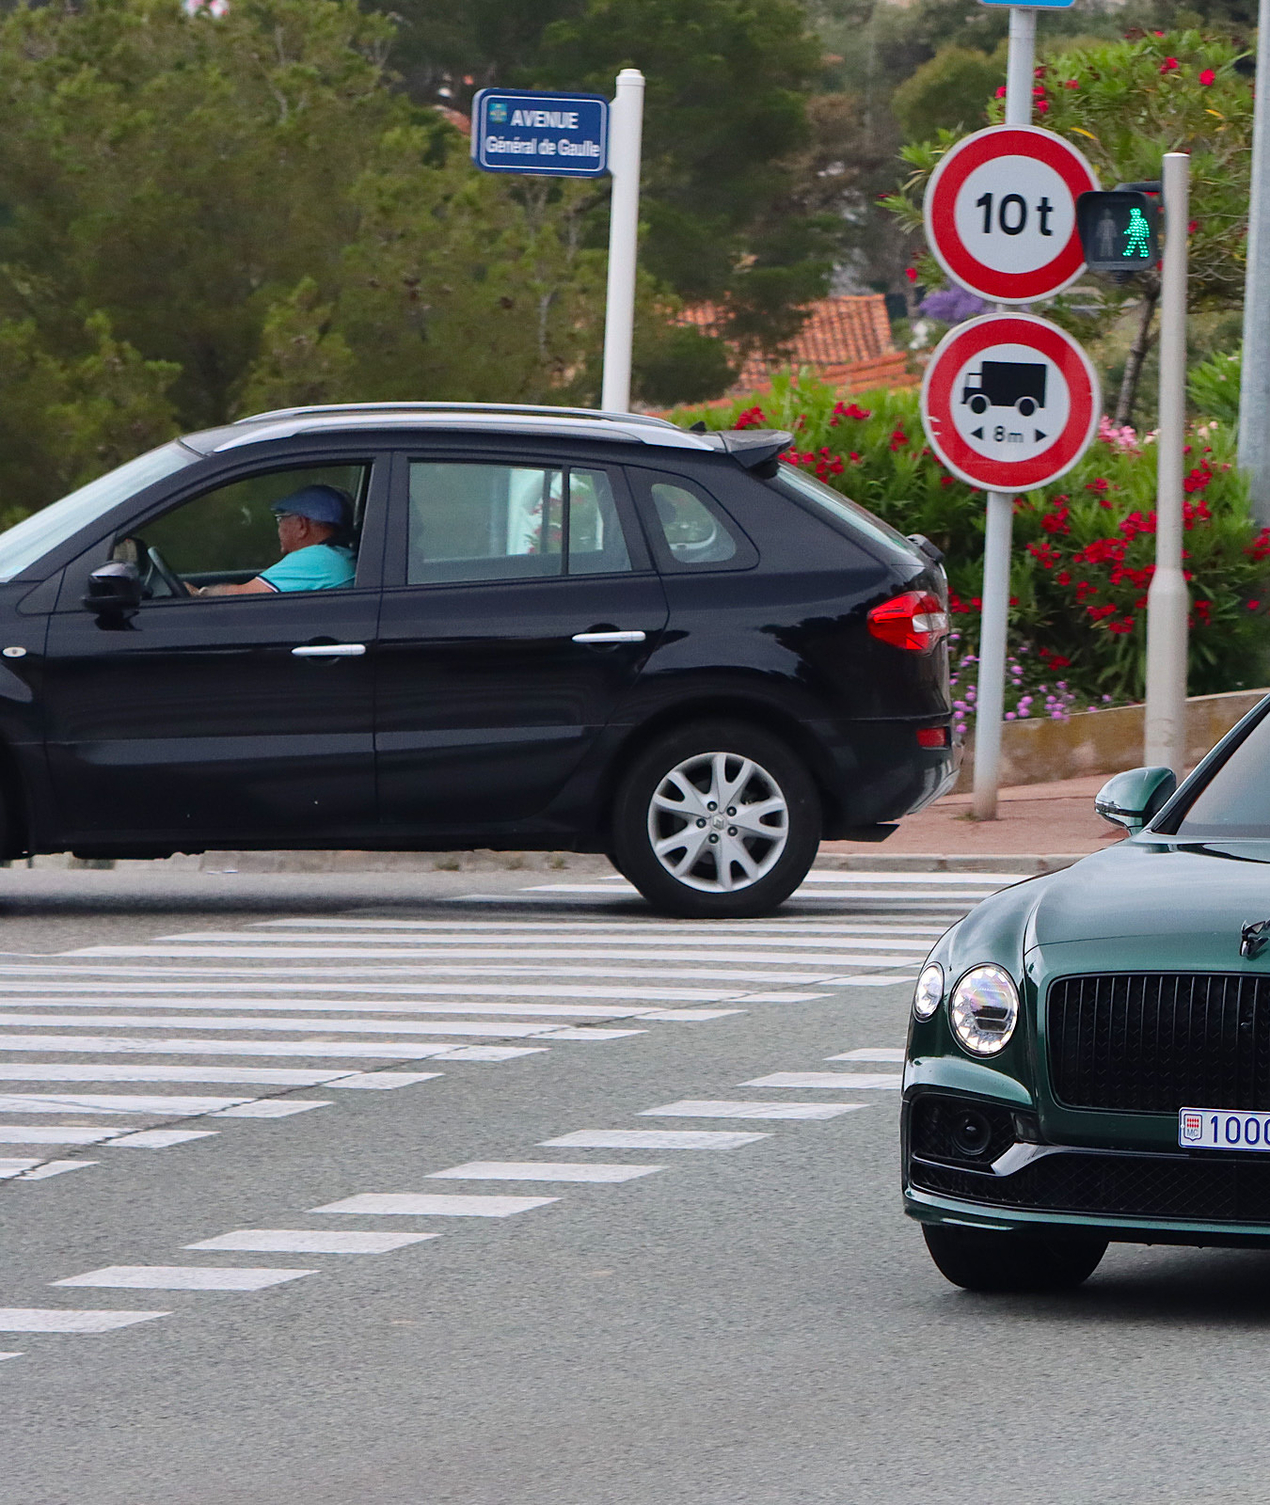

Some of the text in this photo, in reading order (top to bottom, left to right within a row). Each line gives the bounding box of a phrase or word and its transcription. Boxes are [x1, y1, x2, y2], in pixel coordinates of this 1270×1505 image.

[510, 109, 579, 129] AVENUE
[485, 135, 601, 158] Général de Gaulle
